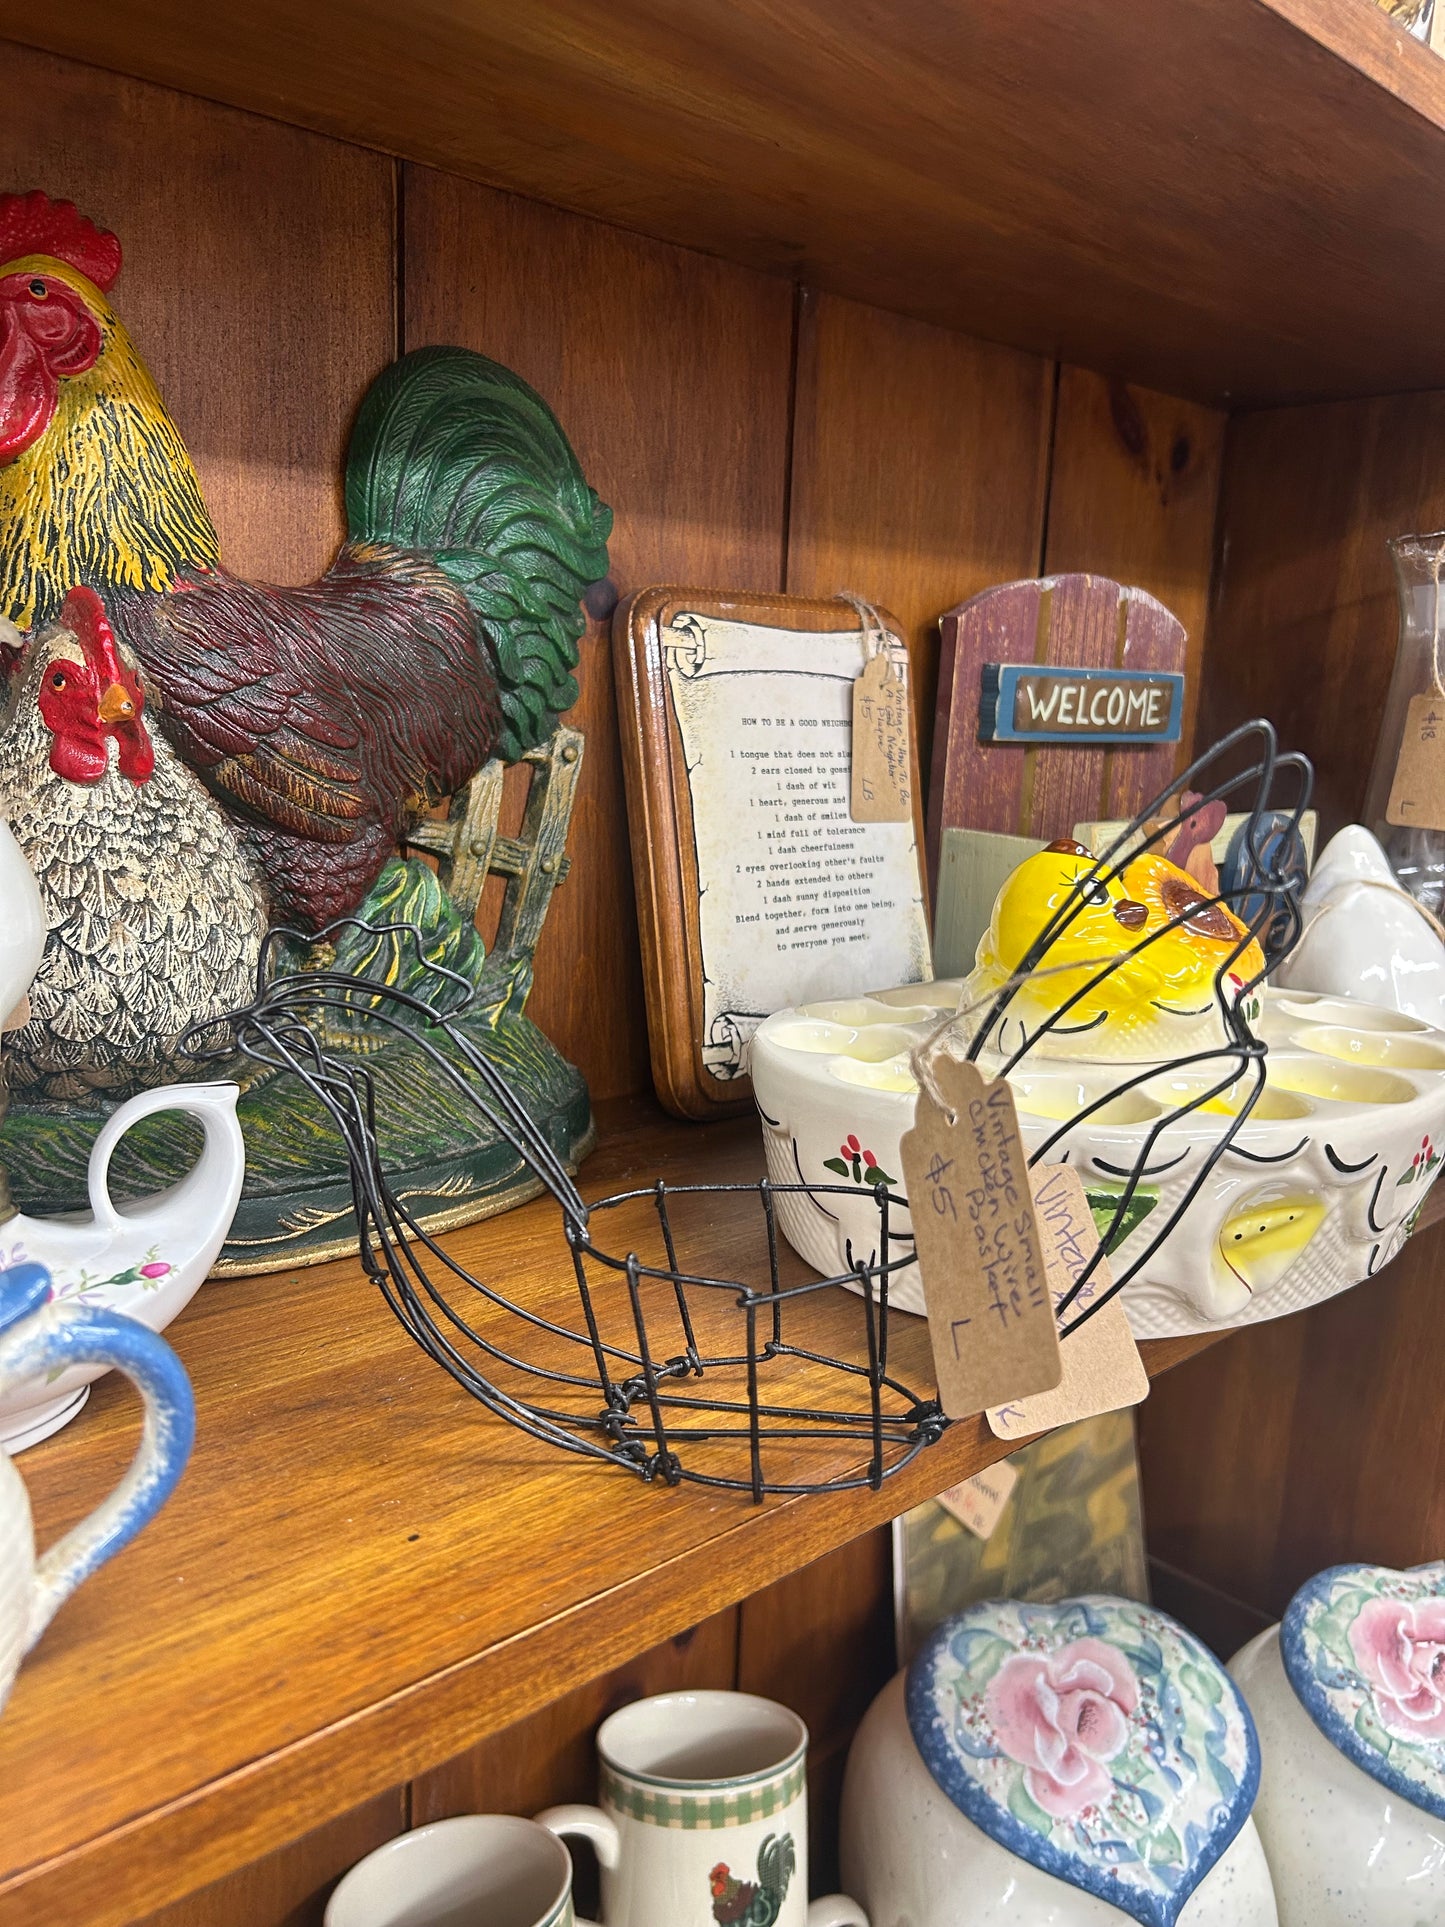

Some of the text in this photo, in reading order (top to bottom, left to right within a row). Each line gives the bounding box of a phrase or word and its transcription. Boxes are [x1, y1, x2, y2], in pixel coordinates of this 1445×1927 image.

[859, 695, 875, 723] $5
[893, 689, 905, 736] Vintage
[1026, 684, 1163, 728] WELCOME
[741, 718, 852, 728] HOW TO BE A GOOD NEIGHBO
[1421, 711, 1443, 741] $18
[730, 750, 735, 758] 1
[740, 751, 769, 760] tongue
[774, 751, 793, 759] that
[797, 750, 816, 758] does
[820, 750, 834, 758] not
[751, 767, 757, 775] 2
[784, 766, 813, 774] closed
[817, 766, 826, 774] to
[786, 782, 805, 790] dash
[809, 782, 818, 790] of
[823, 781, 836, 789] wit
[862, 777, 874, 801] LB
[759, 798, 787, 807] heart,
[791, 798, 829, 807] generous
[832, 796, 846, 804] and
[775, 811, 847, 823] 1 dash of smiles
[757, 826, 866, 839] 1 mind full of tolerance
[768, 842, 854, 855] 1 dash cheerfulness
[735, 854, 884, 874] 2 eyes overlooking other's faults
[757, 872, 873, 889] 2 hands extended to others
[763, 886, 871, 904] 1 dash sunny disposition
[735, 914, 760, 924] Blend
[764, 909, 807, 922] together,
[811, 906, 830, 916] form
[833, 903, 851, 914] into
[854, 903, 868, 911] one
[775, 918, 865, 936] and serve generously
[777, 943, 787, 952] to
[791, 938, 827, 949] everyone
[831, 936, 845, 946] you
[925, 1154, 957, 1222] $5
[986, 1090, 1044, 1307] Vintage Small
[965, 1191, 1009, 1328] Basket
[951, 1317, 972, 1361] L
